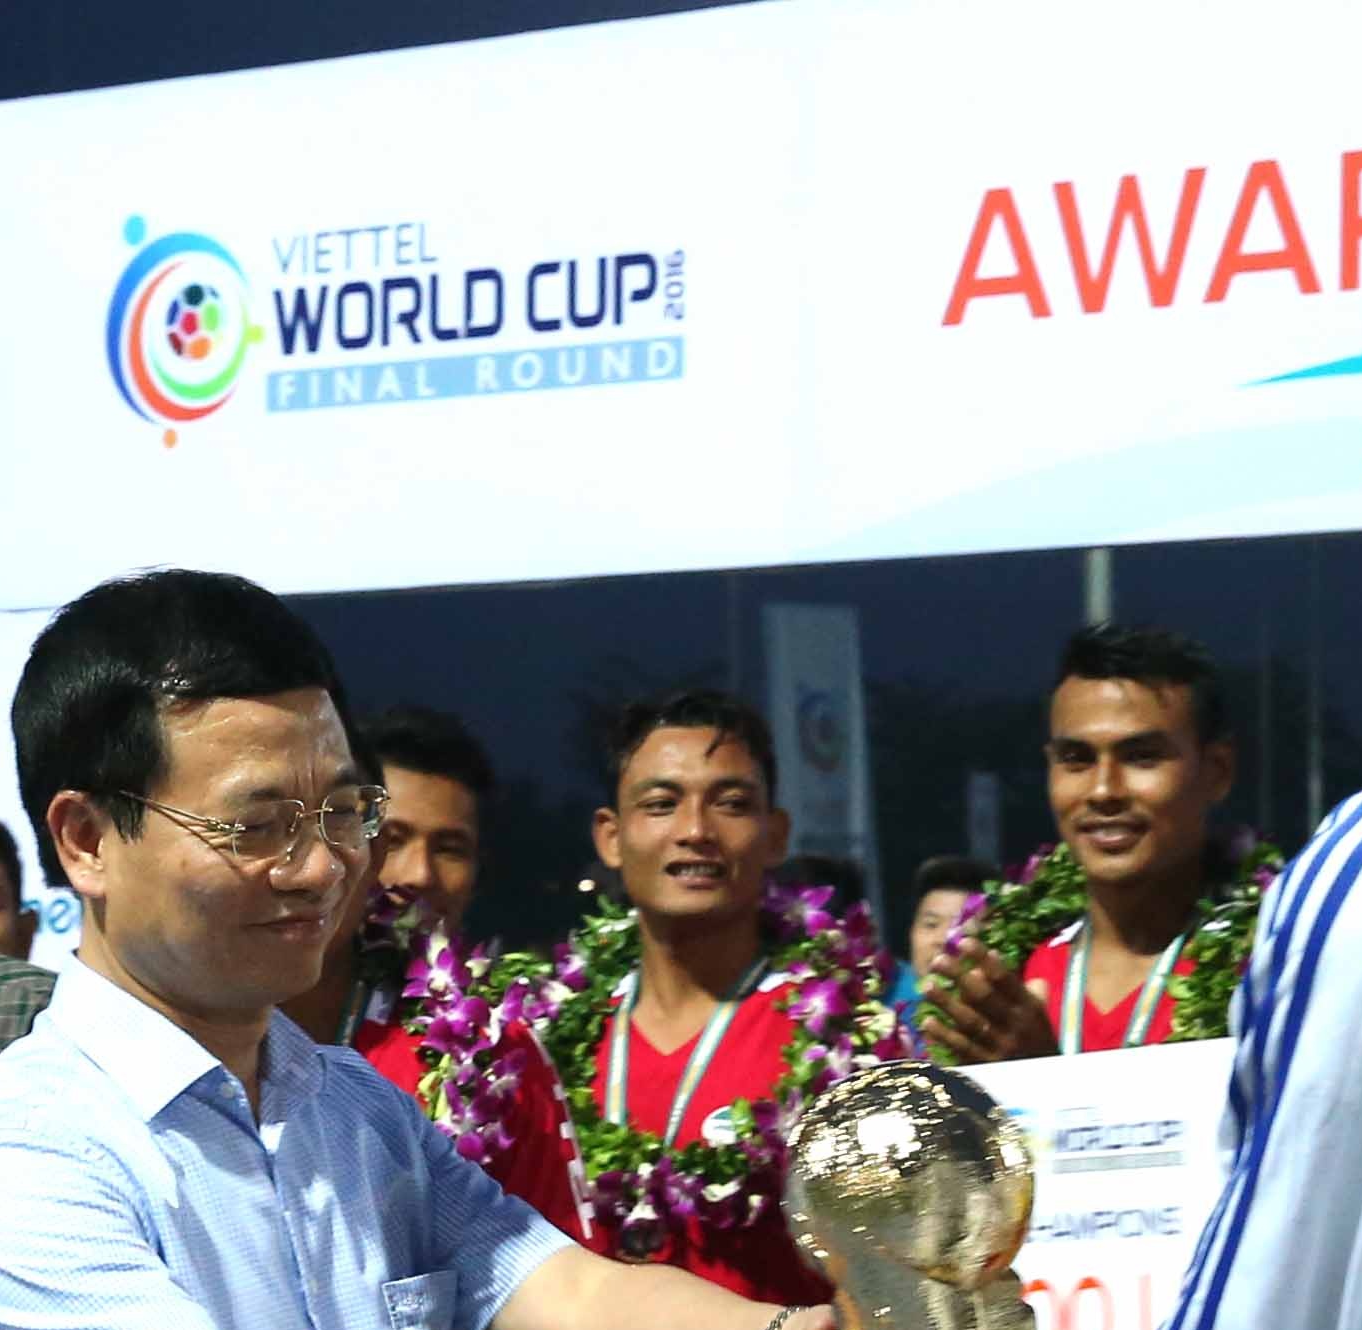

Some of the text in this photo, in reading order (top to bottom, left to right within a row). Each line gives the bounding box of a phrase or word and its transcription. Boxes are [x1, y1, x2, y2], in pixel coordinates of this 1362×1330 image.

[272, 222, 438, 274] VIETTEL
[273, 252, 659, 355] WORLD CUP
[663, 249, 686, 320] 2016
[277, 340, 677, 408] FINAL ROUND
